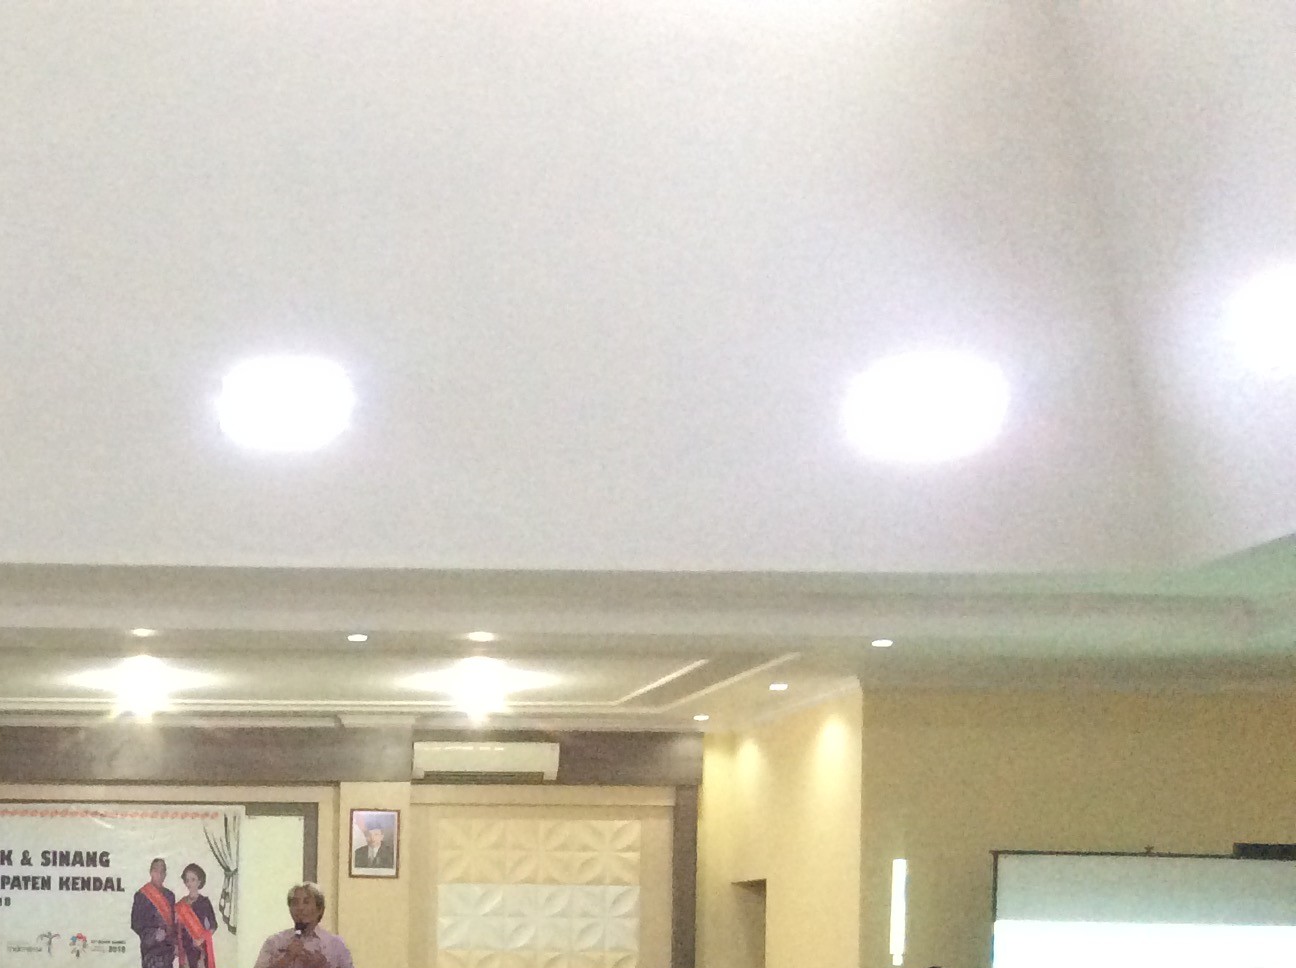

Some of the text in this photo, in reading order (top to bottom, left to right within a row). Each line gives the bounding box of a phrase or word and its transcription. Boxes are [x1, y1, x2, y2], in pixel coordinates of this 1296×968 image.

[20, 850, 33, 867] &
[40, 850, 111, 868] SINANG
[58, 876, 126, 892] KENDAL
